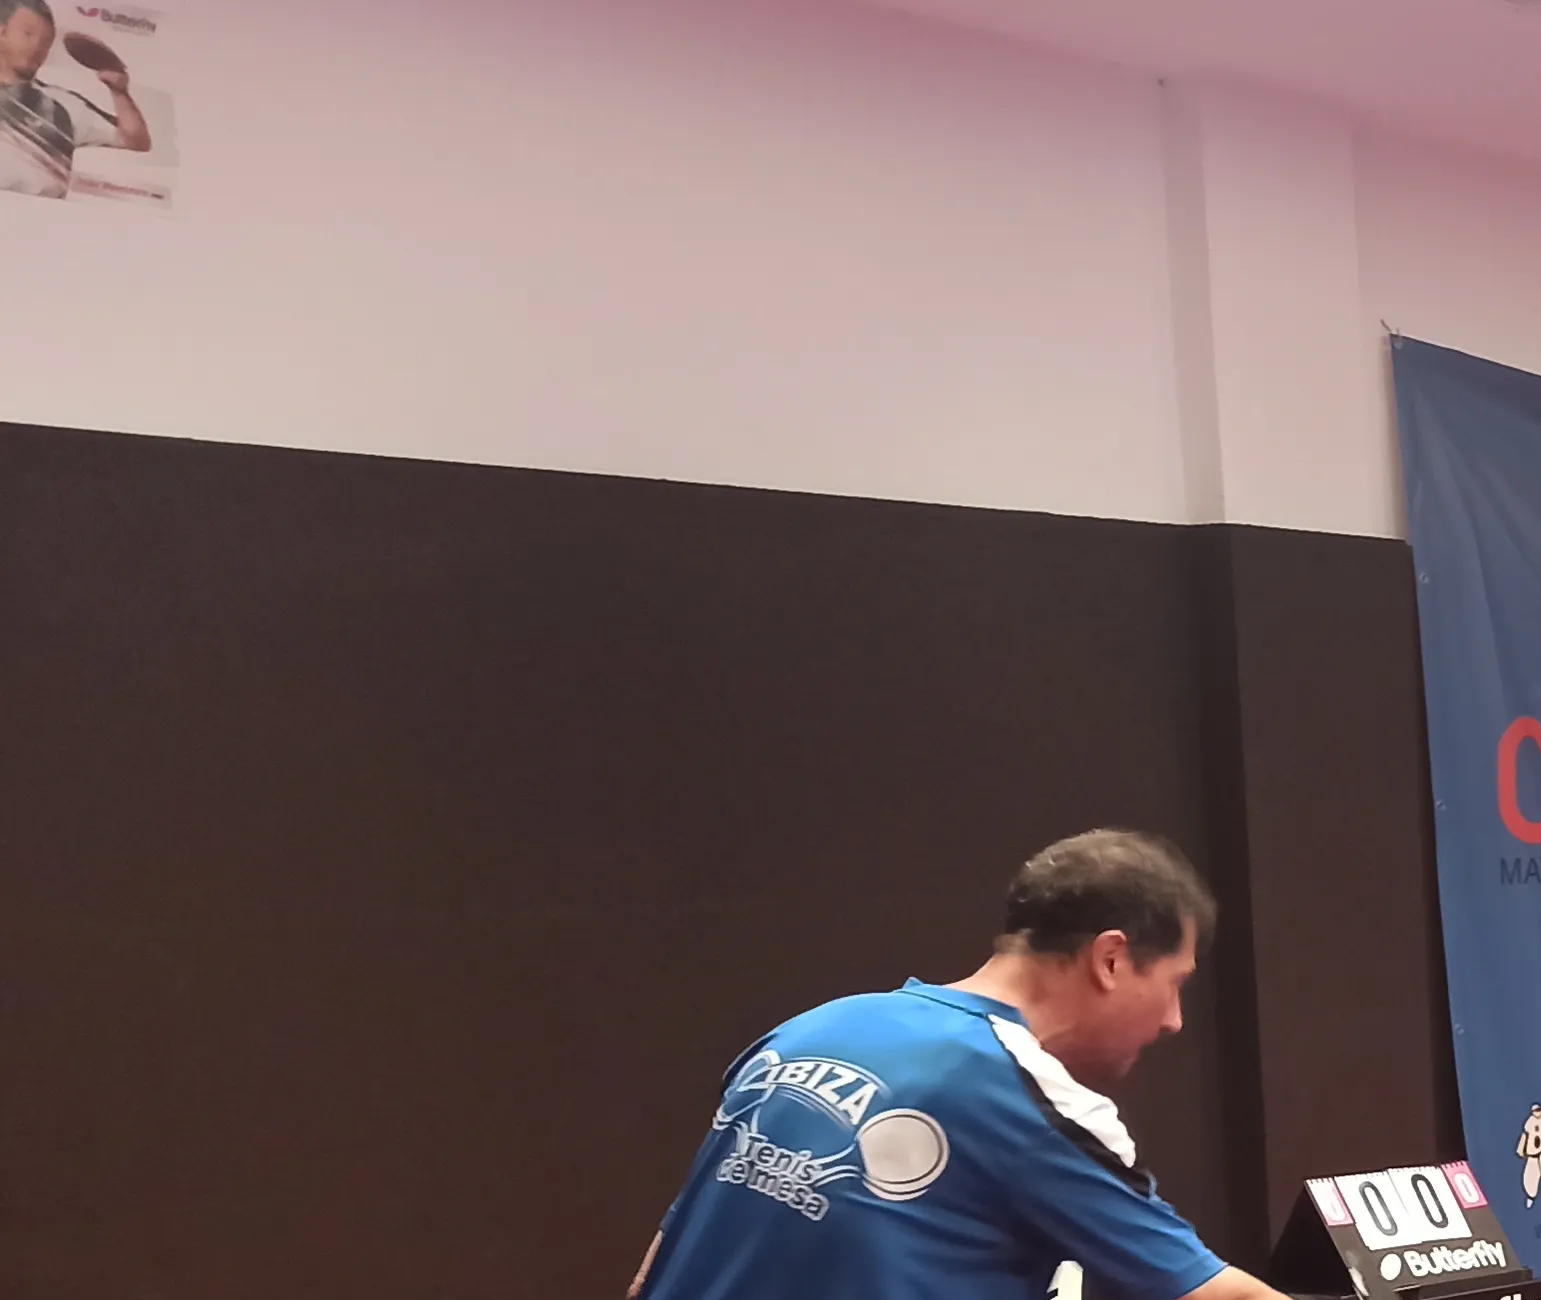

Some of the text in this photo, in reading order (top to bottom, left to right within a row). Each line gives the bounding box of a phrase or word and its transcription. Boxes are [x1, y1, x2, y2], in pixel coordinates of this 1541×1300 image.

[765, 1060, 880, 1126] IBIZA
[1359, 1180, 1398, 1236] 0
[1411, 1173, 1449, 1229] 0
[1404, 1239, 1507, 1277] Butterfly
